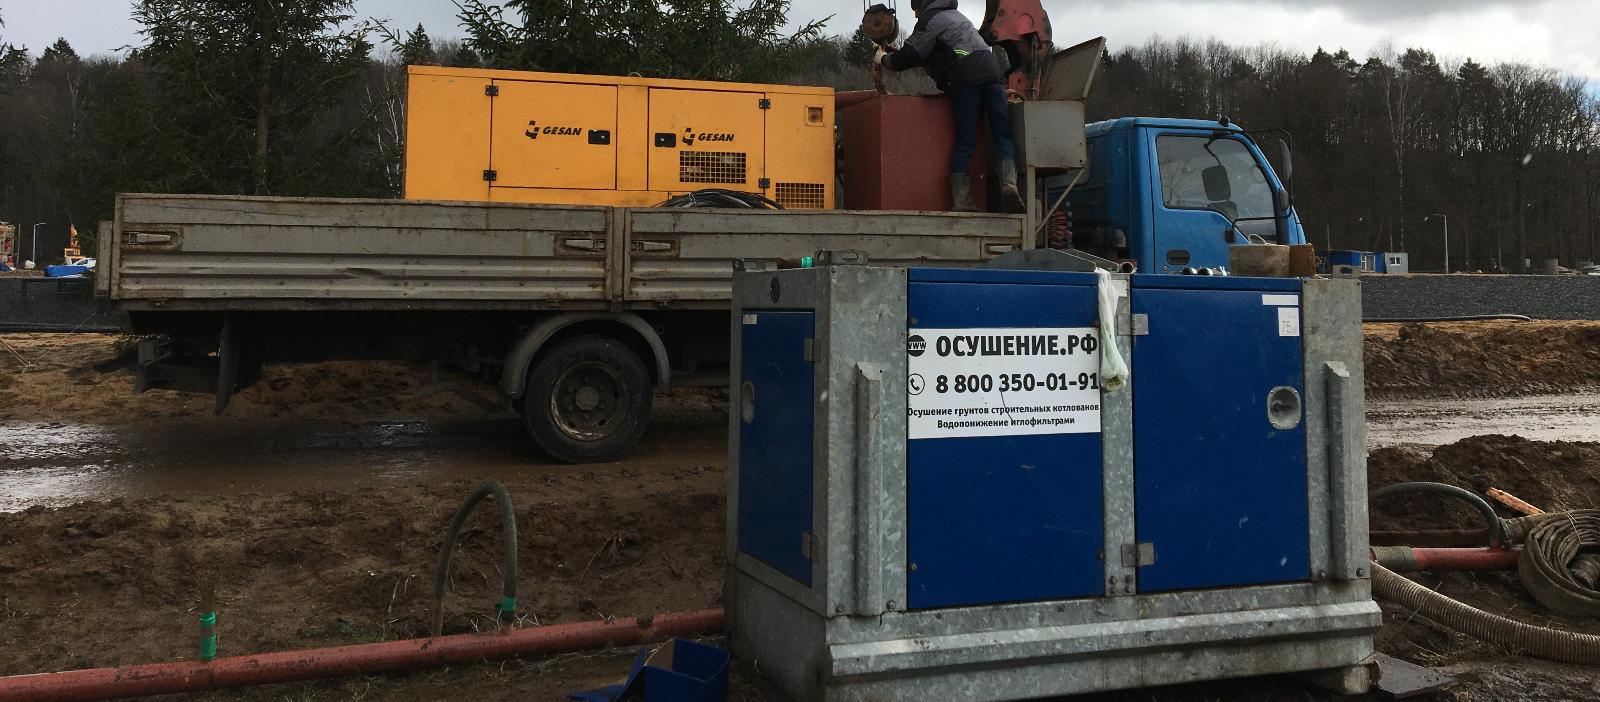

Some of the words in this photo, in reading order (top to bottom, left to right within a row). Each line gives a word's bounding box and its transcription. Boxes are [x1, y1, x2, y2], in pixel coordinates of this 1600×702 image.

[542, 126, 582, 137] GESAN
[698, 132, 735, 142] GESAN
[936, 333, 1098, 357] ОСУШЕНИЕ.РФ
[936, 374, 949, 394] 8
[954, 373, 993, 393] 800
[998, 372, 1099, 393] 350-01-91
[908, 407, 953, 418] Осушение
[954, 407, 989, 417] грунтов
[991, 405, 1051, 415] строительных
[1053, 404, 1099, 412] котлованов
[937, 419, 1009, 429] Водопонижение
[1010, 417, 1075, 427] иглофильтрами
